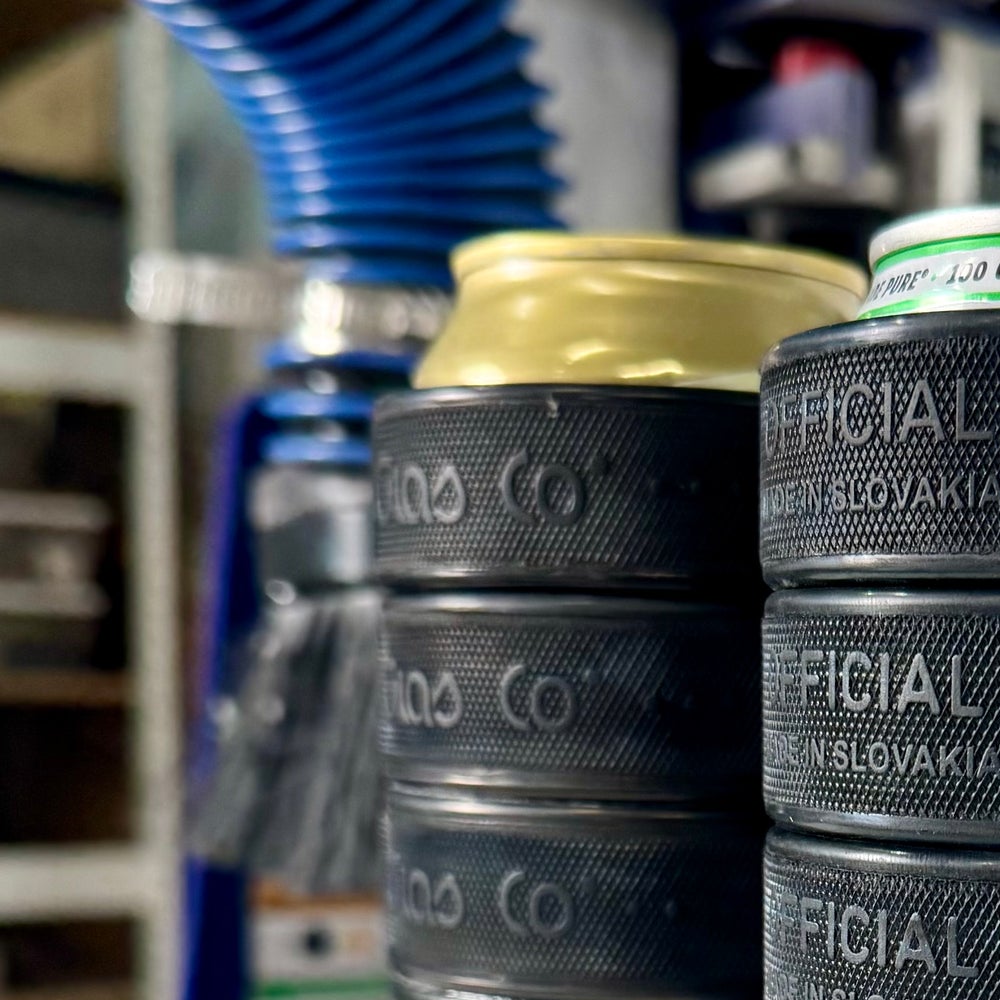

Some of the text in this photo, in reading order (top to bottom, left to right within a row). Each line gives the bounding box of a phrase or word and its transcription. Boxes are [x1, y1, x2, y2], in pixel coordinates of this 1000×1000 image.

[946, 261, 987, 285] 100
[800, 481, 824, 514] IN
[501, 664, 575, 731] Co
[805, 738, 826, 770] IN
[501, 869, 574, 939] Co
[772, 893, 979, 978] FFICIAL
